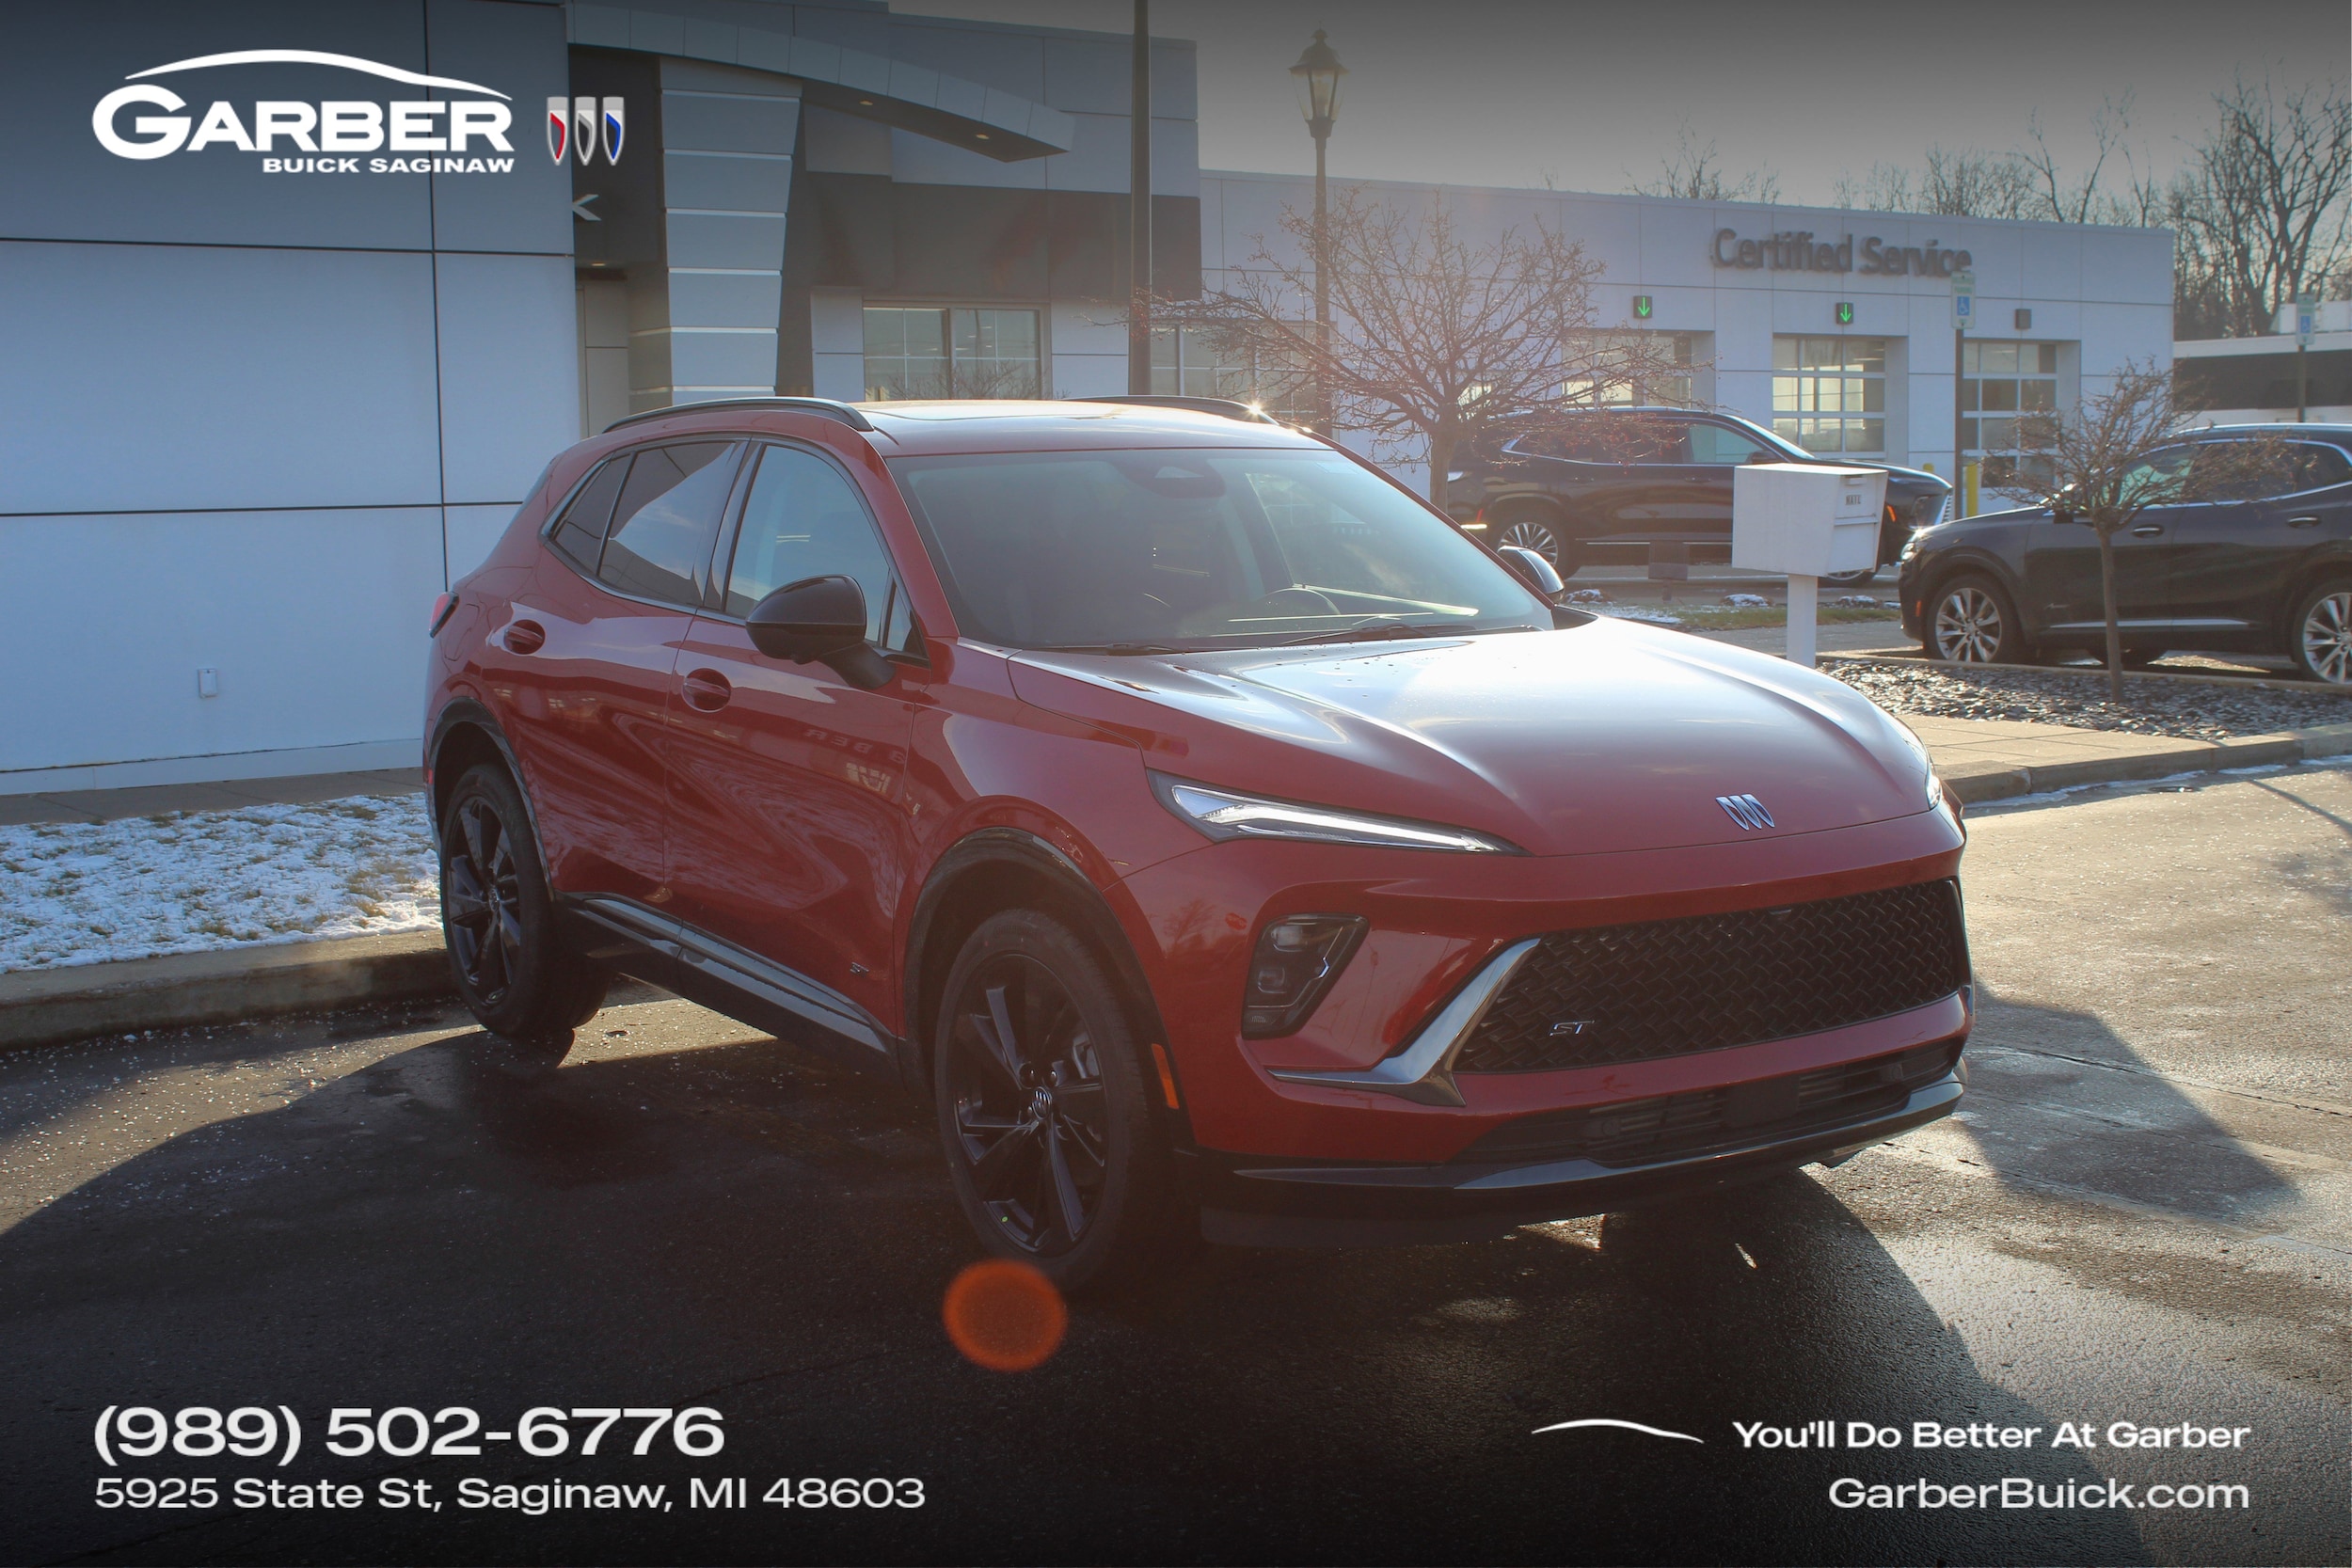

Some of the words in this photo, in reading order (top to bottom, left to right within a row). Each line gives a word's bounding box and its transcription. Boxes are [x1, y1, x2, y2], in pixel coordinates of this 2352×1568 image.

[1710, 228, 1853, 272] Certified
[1857, 236, 1973, 277] Service
[1549, 1020, 1596, 1037] ST
